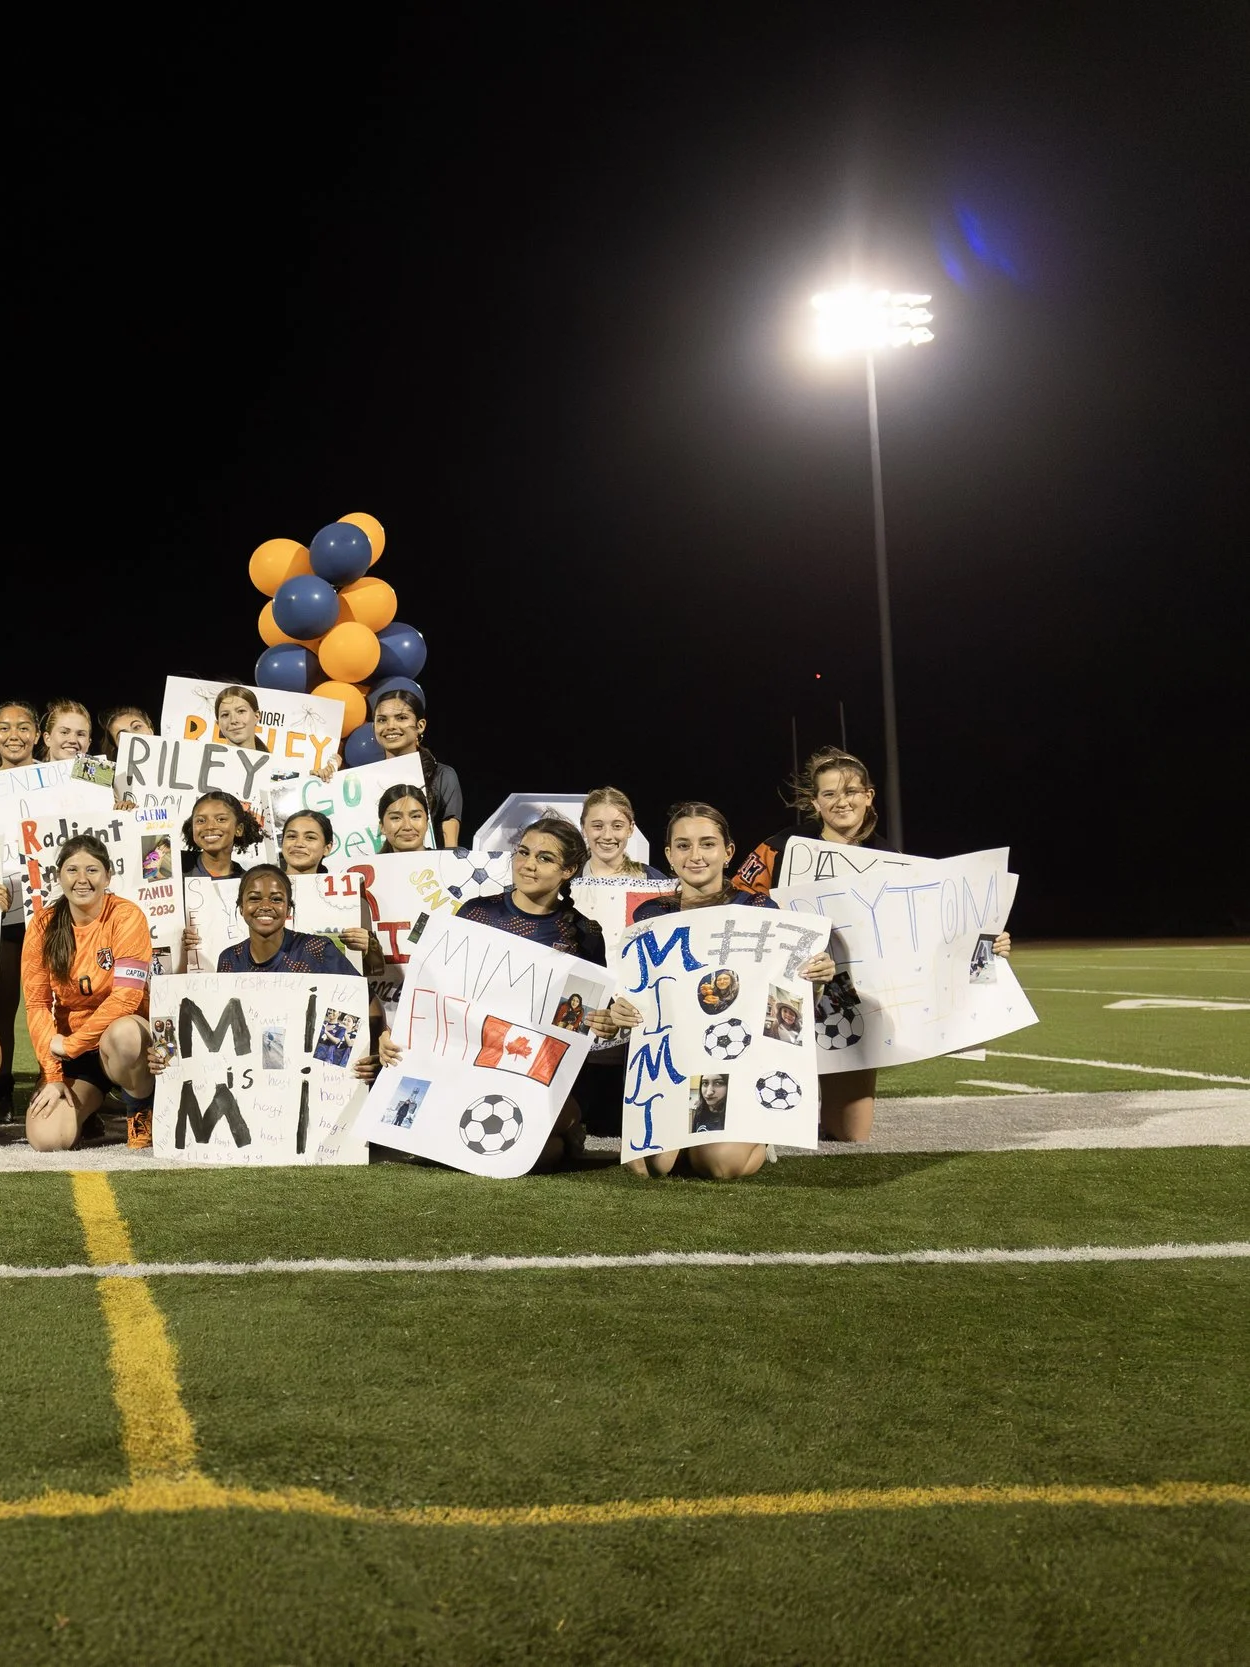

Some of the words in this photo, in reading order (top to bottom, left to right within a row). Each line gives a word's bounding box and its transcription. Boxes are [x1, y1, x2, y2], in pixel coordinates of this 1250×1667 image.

[126, 736, 270, 800] RILEY
[135, 808, 168, 822] GLENN
[323, 874, 358, 897] 11
[149, 904, 176, 917] 2030
[706, 919, 824, 982] #7
[125, 968, 146, 979] CAPTAIN
[417, 929, 554, 1026] MIMI
[226, 1066, 254, 1090] is
